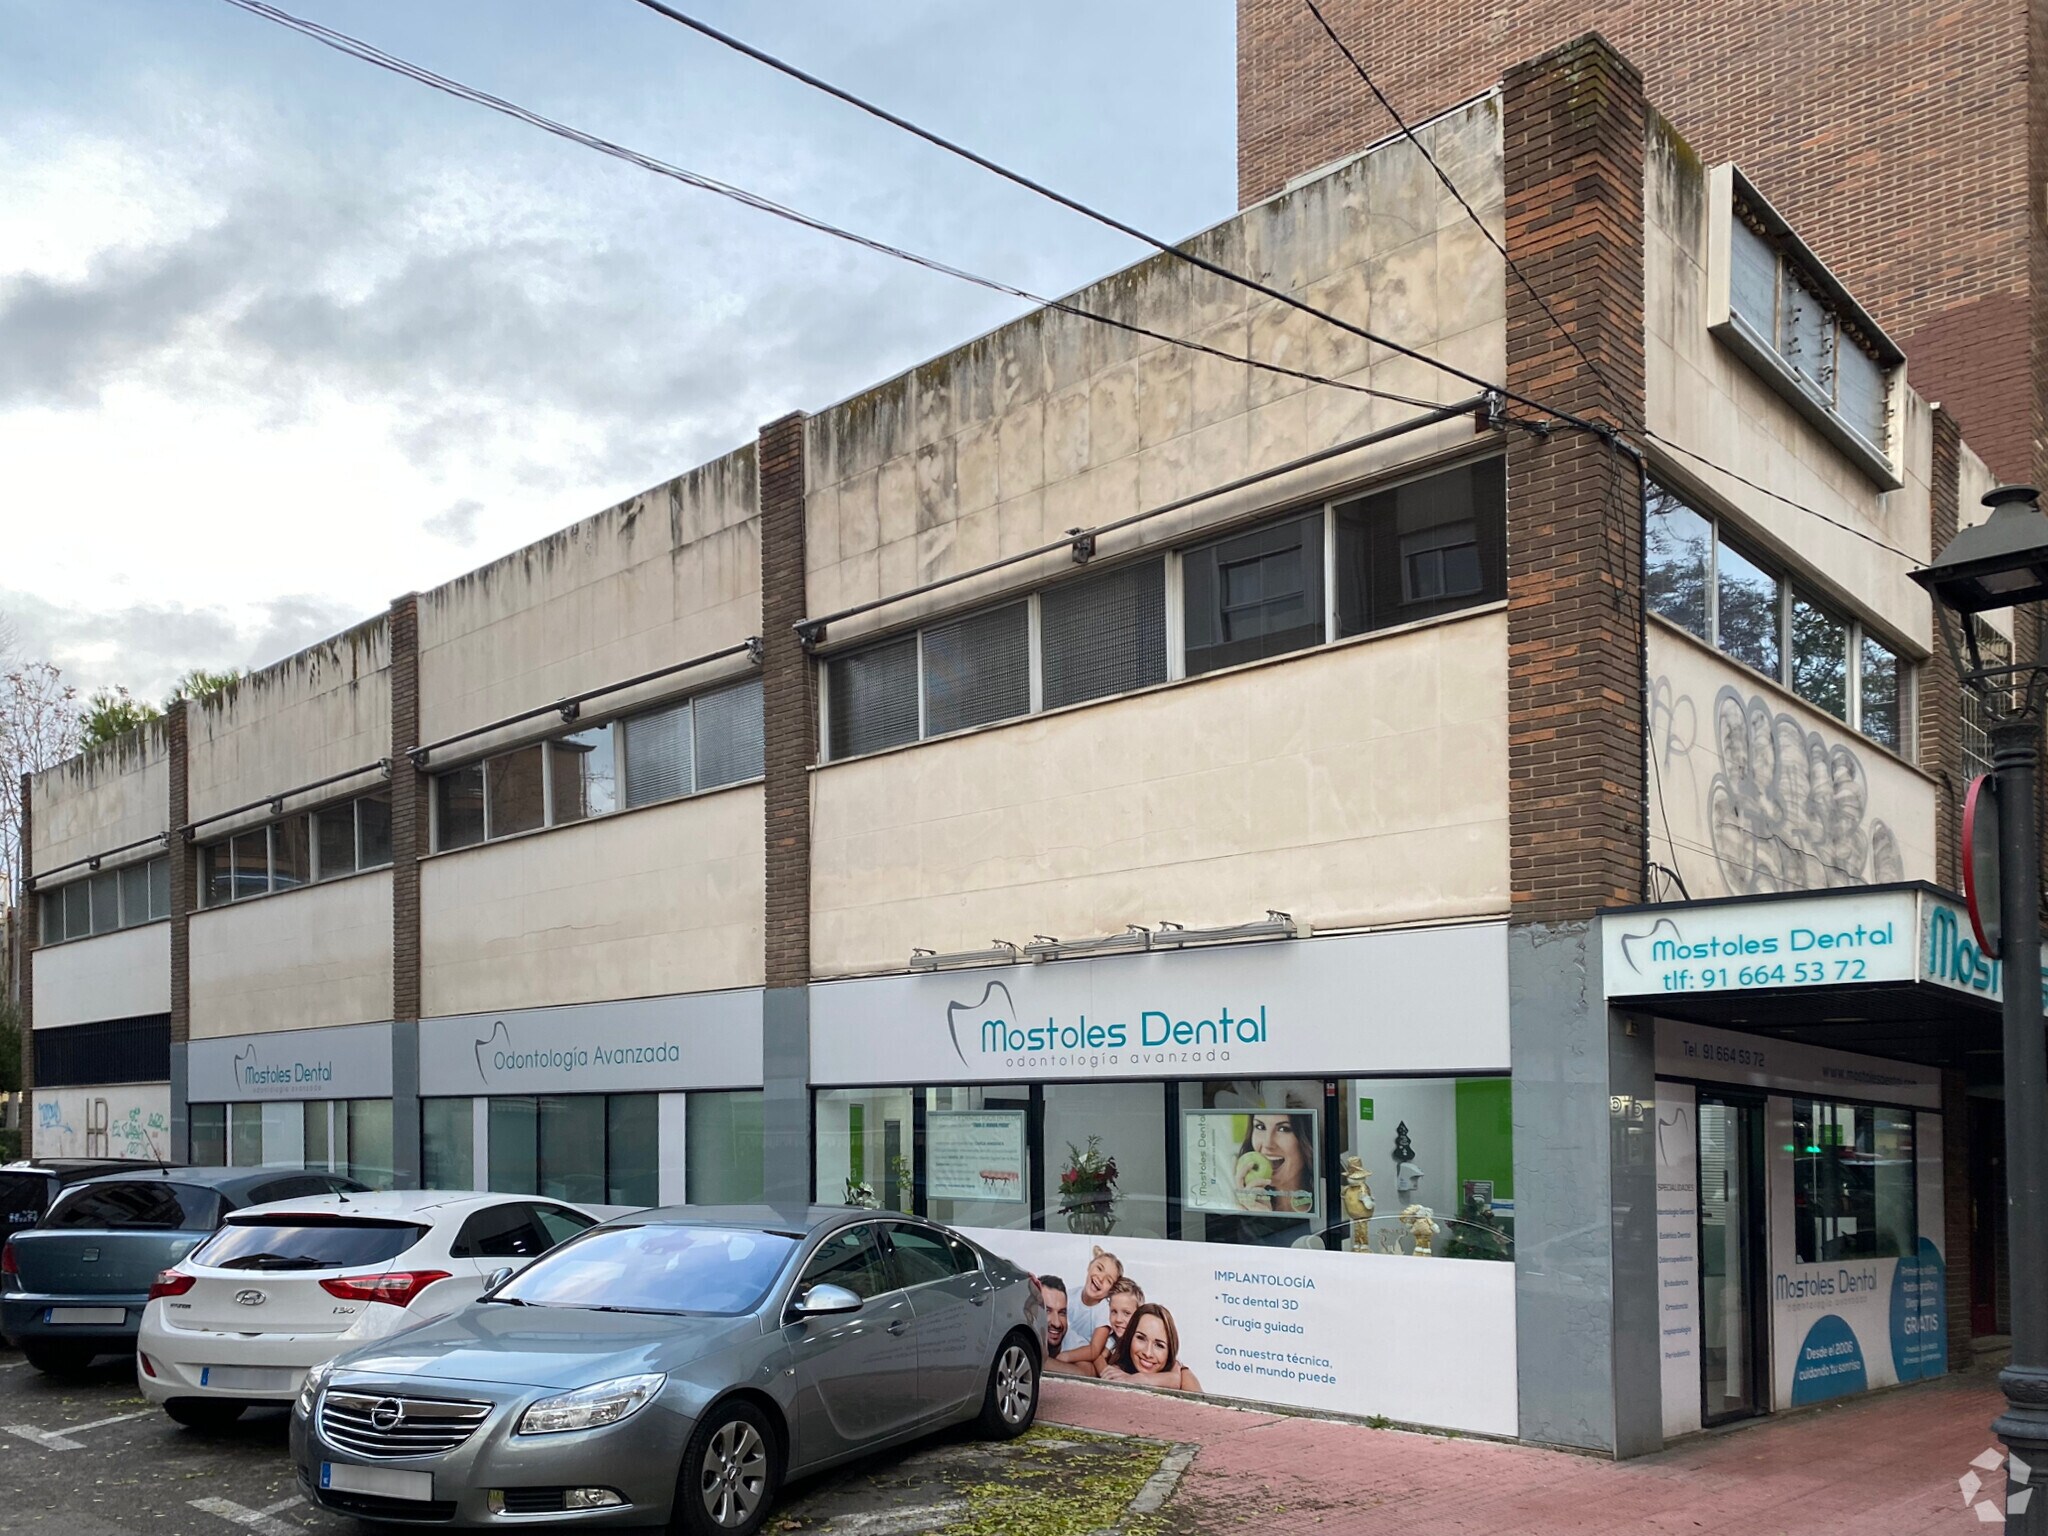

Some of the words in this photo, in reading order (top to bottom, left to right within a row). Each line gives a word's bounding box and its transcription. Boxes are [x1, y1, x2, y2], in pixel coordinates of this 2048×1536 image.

[1653, 934, 1778, 961] Mostoles
[1791, 922, 1893, 951] Dental
[1663, 969, 1694, 991] tlf:
[1702, 968, 1727, 988] 91
[1739, 964, 1786, 985] 664
[1794, 962, 1824, 983] 53
[1835, 959, 1866, 980] 72
[982, 1015, 1127, 1052] Mostoles
[1142, 1005, 1266, 1046] Dental
[494, 1046, 587, 1071] Odontología
[593, 1042, 680, 1065] Avanzada
[1006, 1053, 1118, 1068] odontología
[1130, 1049, 1230, 1064] avanzada
[1703, 1044, 1713, 1060] 91
[1716, 1046, 1736, 1063] 664
[1738, 1049, 1751, 1065] 53
[1753, 1052, 1764, 1067] 72
[245, 1064, 291, 1084] Mostoles
[295, 1061, 332, 1083] Dental
[1199, 1149, 1208, 1196] Mostoles
[1657, 1183, 1695, 1191] SPECIALIDADES
[1214, 1271, 1316, 1289] IMPLANTOLOGÍA
[1776, 1271, 1835, 1300] Mostoles
[1839, 1267, 1877, 1293] Dental
[1222, 1293, 1240, 1305] Tac
[1242, 1296, 1279, 1309] dental
[1282, 1299, 1299, 1310] 3D
[1264, 1321, 1304, 1335] guiada
[1904, 1314, 1939, 1335] GRATIS
[1215, 1343, 1237, 1356] Con
[1239, 1349, 1284, 1362] nuestra
[1806, 1345, 1828, 1361] Desde
[1216, 1360, 1241, 1371] todo
[1243, 1364, 1253, 1373] el
[1256, 1365, 1295, 1379] mundo
[1298, 1372, 1336, 1384] puede
